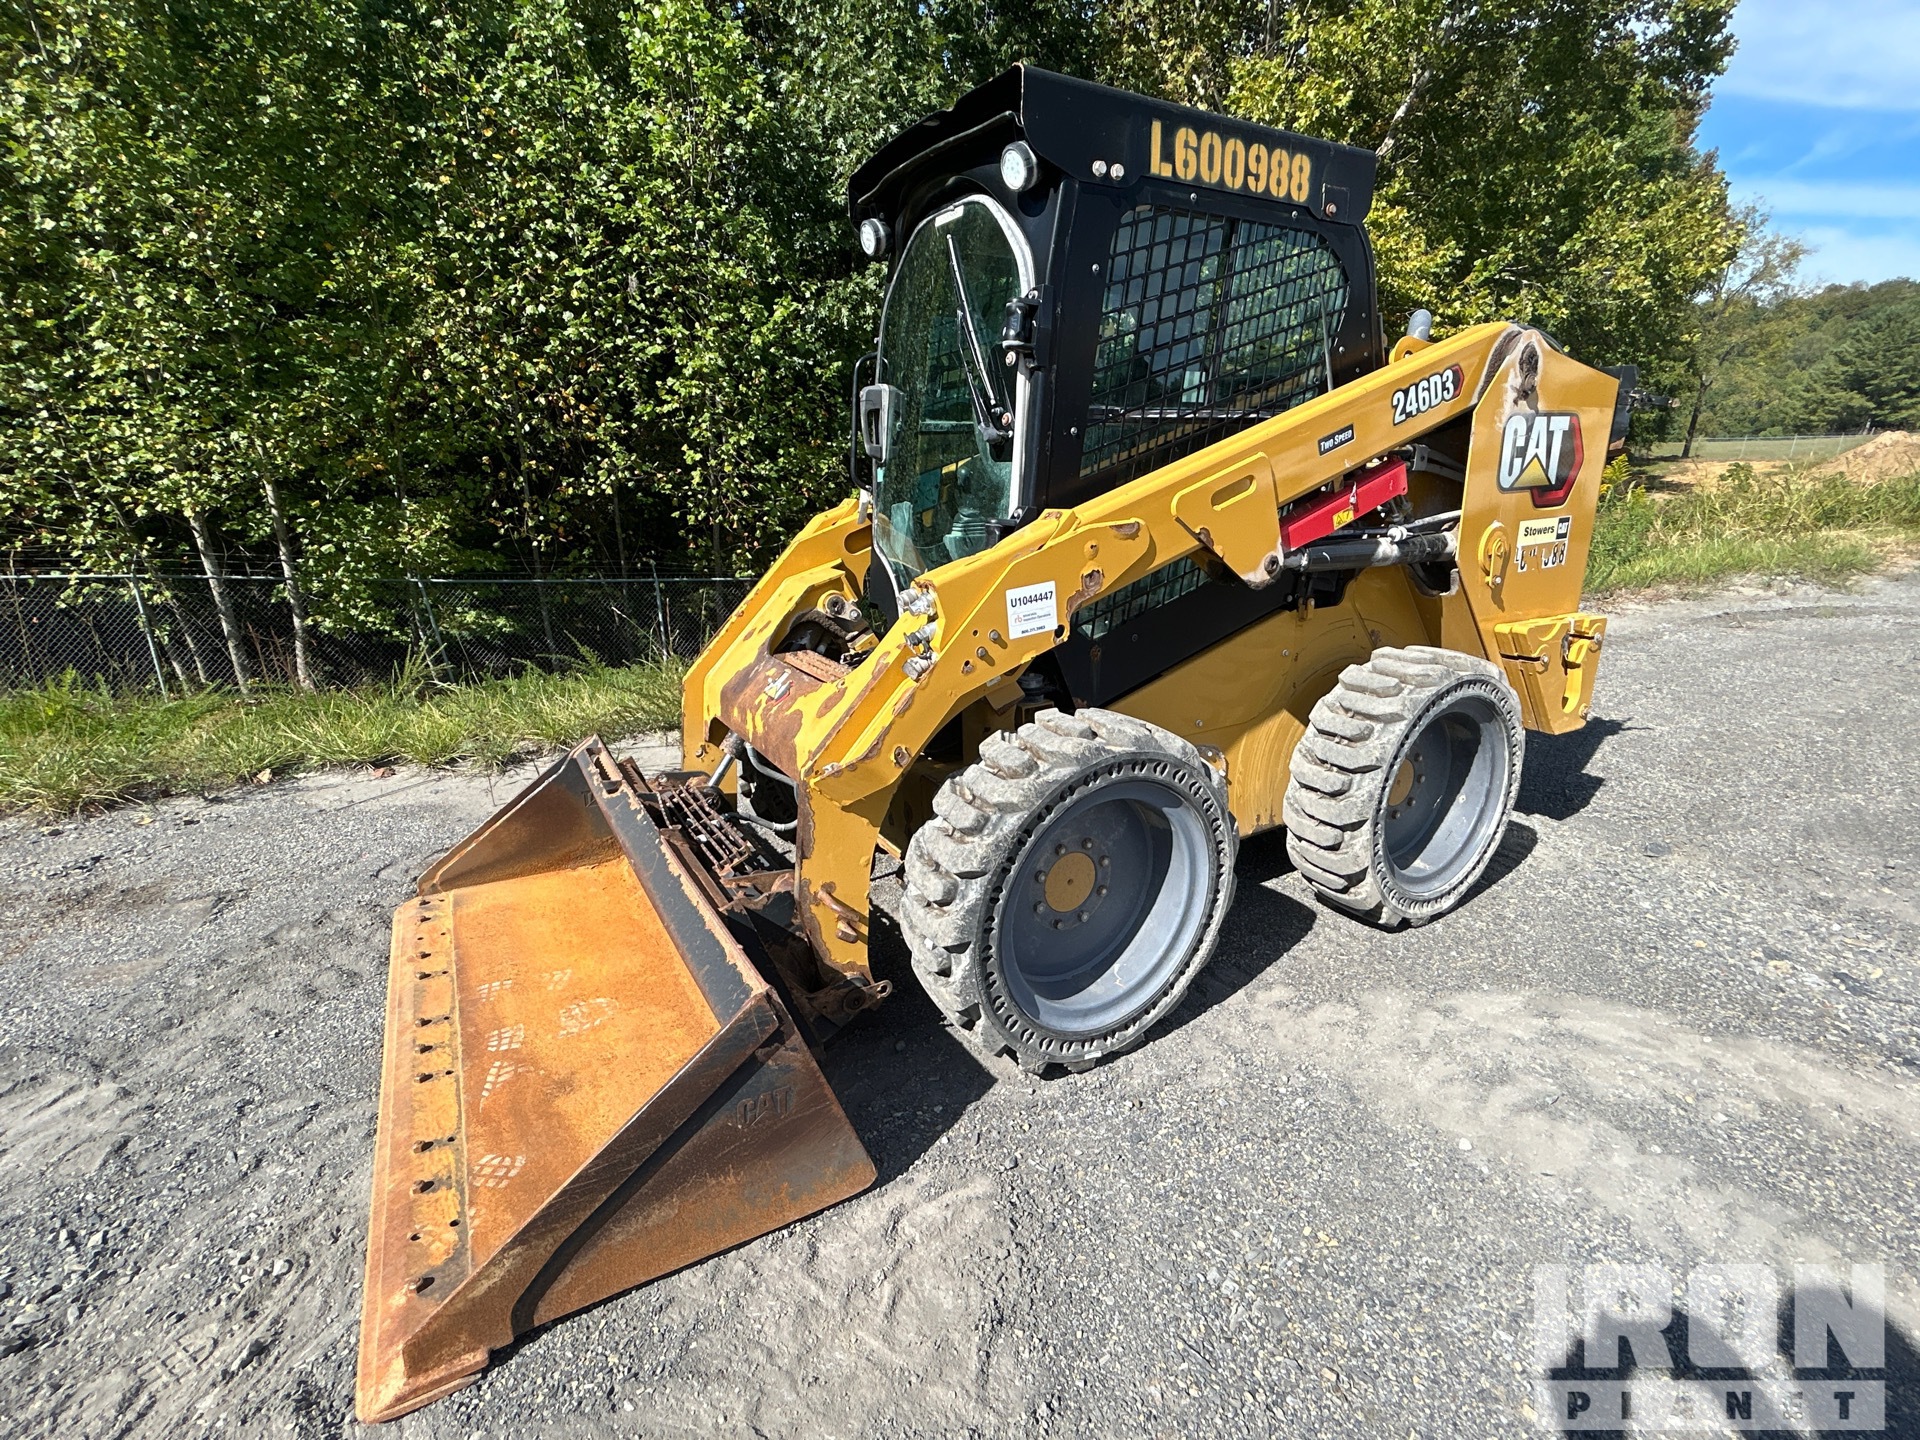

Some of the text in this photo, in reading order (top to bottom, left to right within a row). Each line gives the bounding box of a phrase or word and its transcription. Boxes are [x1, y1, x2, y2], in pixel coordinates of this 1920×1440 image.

[1151, 119, 1311, 202] L600988
[1392, 367, 1455, 425] 246D3
[1499, 415, 1571, 489] CAT
[1523, 525, 1555, 537] Stowers
[1010, 590, 1053, 608] U1044447
[736, 1085, 792, 1127] CAT
